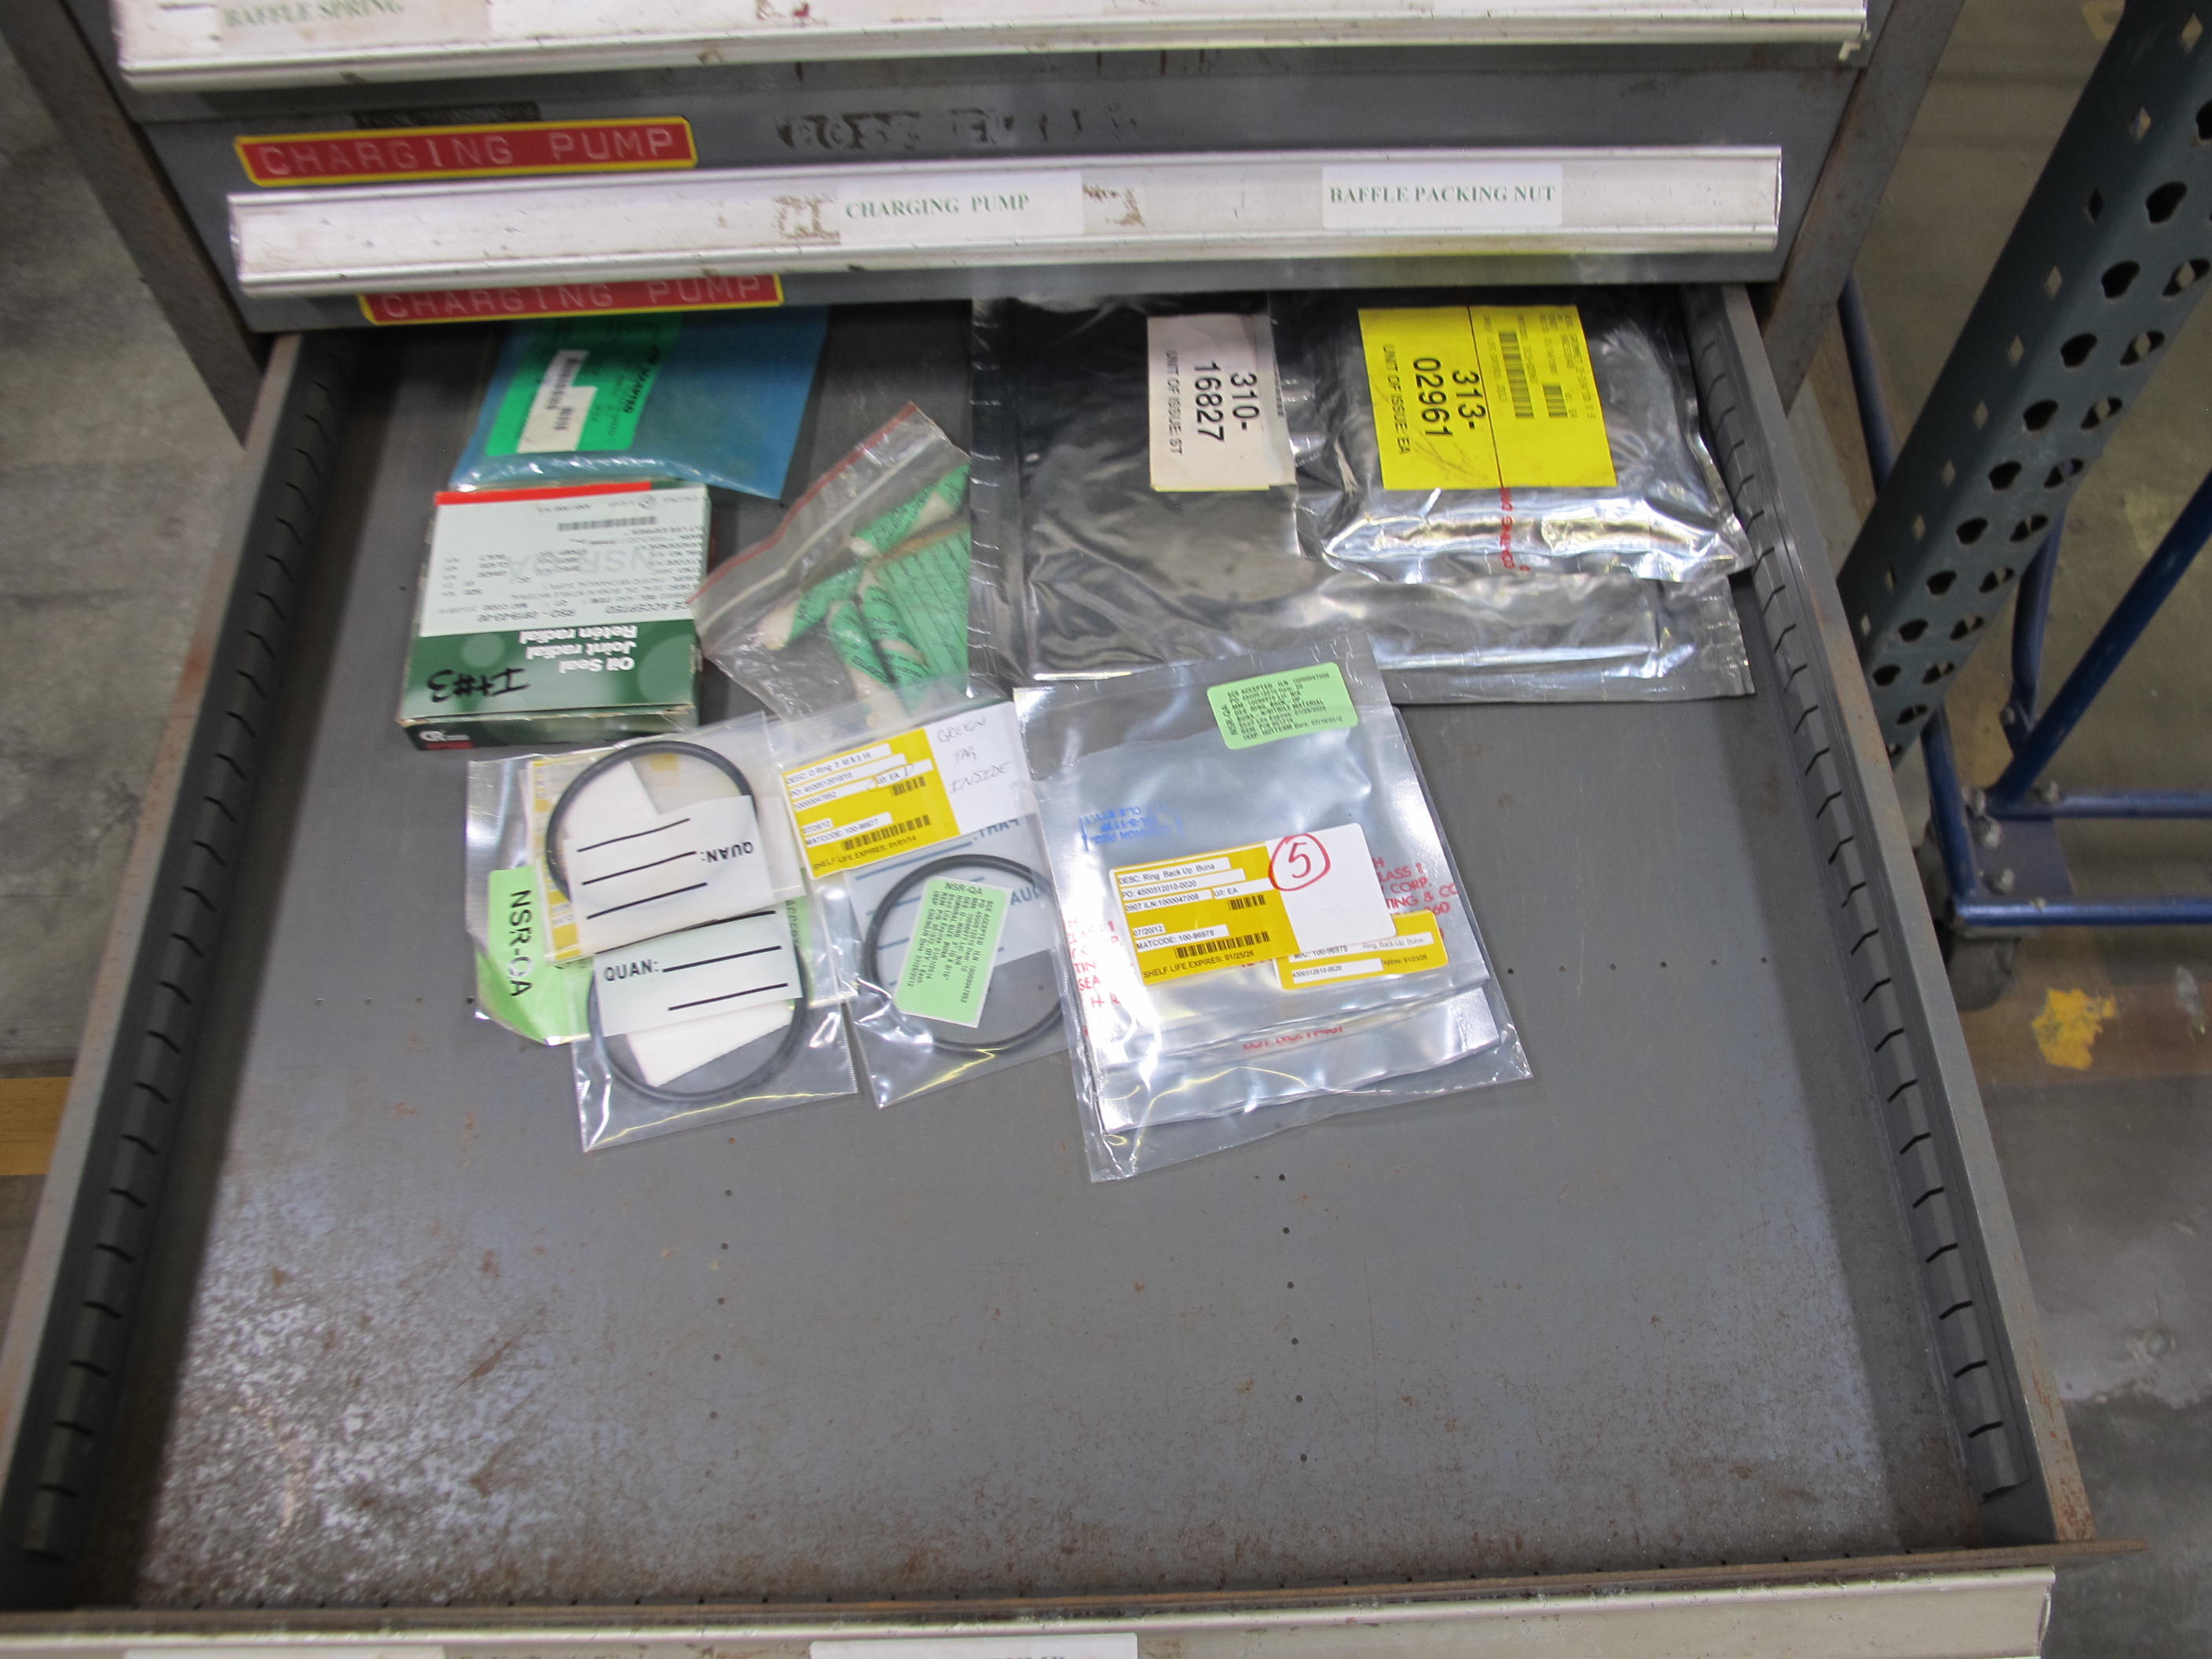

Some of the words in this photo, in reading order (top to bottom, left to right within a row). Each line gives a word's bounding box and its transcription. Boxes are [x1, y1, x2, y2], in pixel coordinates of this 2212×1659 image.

[258, 134, 515, 176] CHARGING
[550, 126, 674, 161] PUMP
[1329, 185, 1408, 203] BAFFLE
[1414, 185, 1507, 203] PACKING
[1514, 185, 1556, 203] NUT
[844, 196, 959, 221] CHARGING
[971, 193, 1031, 213] PUMP
[380, 283, 613, 320] CHARGING
[647, 274, 760, 305] PUMP
[1193, 361, 1227, 442] 16827
[1229, 372, 1263, 430] 310-
[1412, 357, 1453, 437] 02961
[1451, 370, 1489, 429] 313-
[1386, 376, 1401, 391] OF
[1396, 438, 1412, 454] EA
[518, 629, 578, 645] radial
[586, 638, 638, 658] Joint
[526, 642, 584, 660] radial
[558, 658, 604, 674] Seal
[606, 655, 636, 672] Oil
[700, 841, 754, 863] QUAN:
[1287, 841, 1312, 880] 5
[1117, 873, 1141, 885] DESC:
[1142, 871, 1160, 882] Ring
[1163, 869, 1181, 877] Back
[1181, 866, 1193, 876] Up
[1196, 862, 1215, 872] Buna
[1377, 862, 1411, 883] LASS
[1389, 877, 1433, 893] CORP.
[508, 889, 534, 998] NSR-QA
[1135, 936, 1177, 950] MATCODE:
[602, 957, 661, 983] QUAN:
[1144, 967, 1168, 977] SHELF
[1169, 962, 1188, 972] LIFE
[1188, 956, 1223, 968] EXPIRES:
